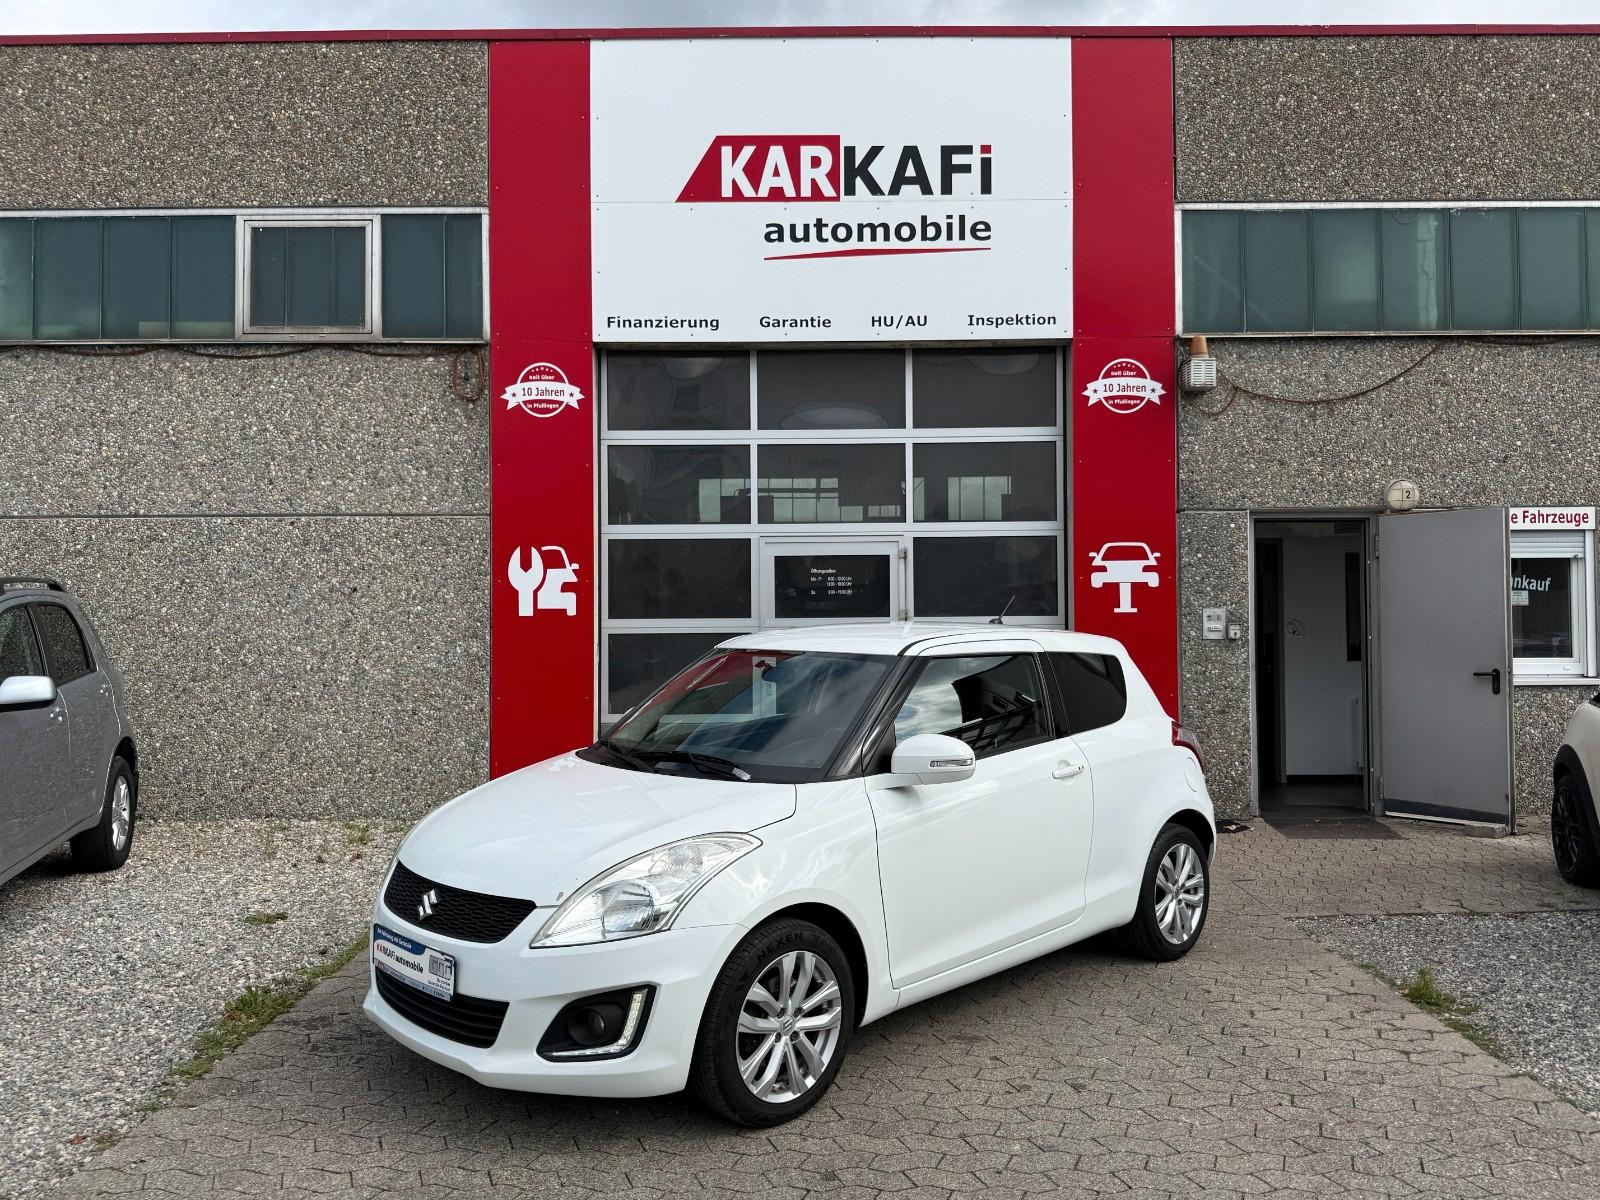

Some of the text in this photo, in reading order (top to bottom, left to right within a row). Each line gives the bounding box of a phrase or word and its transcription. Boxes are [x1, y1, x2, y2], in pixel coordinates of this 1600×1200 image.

[763, 214, 992, 243] automobile
[606, 313, 1057, 332] Finanzierung Garantie HU/AU Inspektion
[521, 387, 565, 397] 10 Jahren
[1103, 383, 1147, 393] 10 Jahren
[1405, 490, 1411, 499] 2
[1522, 509, 1589, 527] Fahrzeuge
[1511, 574, 1551, 592] nkauf
[757, 932, 804, 962] NEXEN
